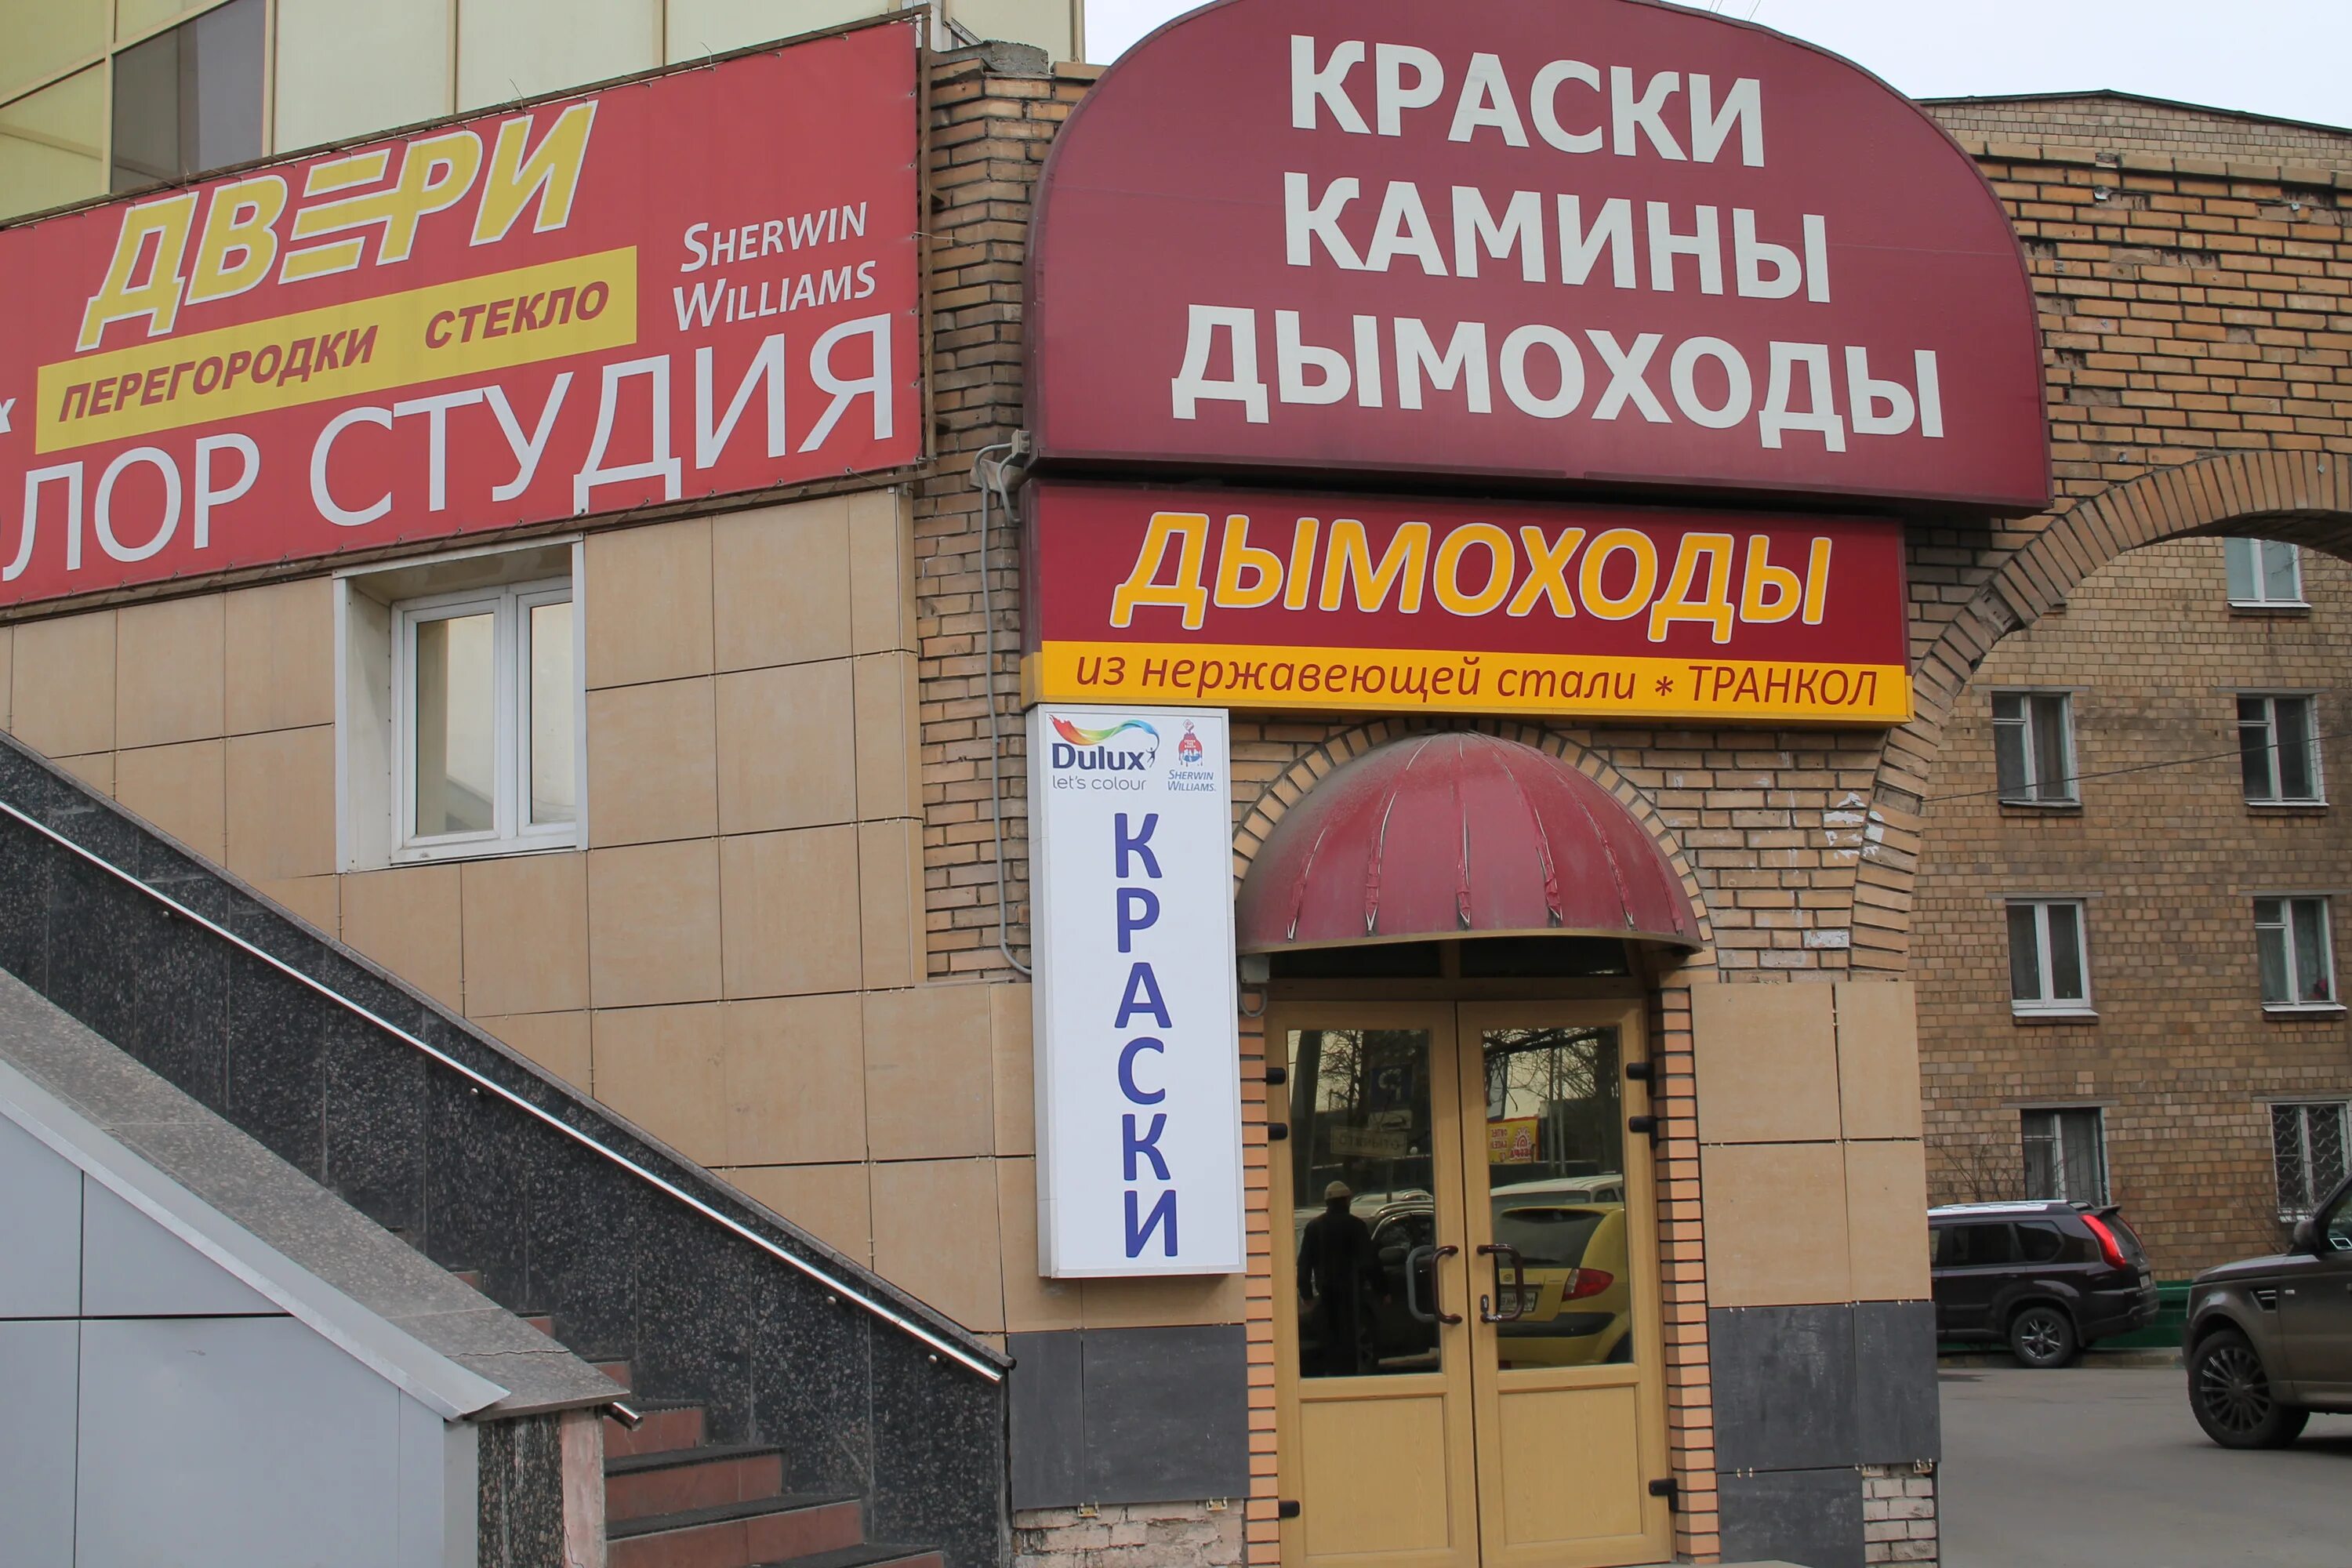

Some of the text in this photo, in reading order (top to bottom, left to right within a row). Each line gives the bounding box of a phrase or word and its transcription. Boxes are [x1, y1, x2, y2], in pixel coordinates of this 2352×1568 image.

[1290, 35, 1765, 167] КРАСКИ
[75, 100, 598, 353] ДВЕРИ
[680, 201, 867, 273] SHERWIN
[1283, 172, 1830, 303] КАМИНЫ
[59, 325, 378, 423] ПЕРЕГОРОДКИ
[426, 281, 609, 349] СТЕКЛО
[673, 260, 877, 332] WILLIAMS
[310, 314, 892, 514] СТУДИЯ
[1171, 304, 1944, 452] ДЫМОХОДЫ
[1109, 511, 1832, 644] ДЫМОХОДЫ
[1076, 656, 1878, 706] из нержавеющей стали ТРАНКОЛ
[1051, 742, 1145, 771] Dulux
[1052, 775, 1147, 791] let's colour
[1167, 769, 1214, 780] SHERWIN
[1114, 812, 1178, 1258] КРАСКИ
